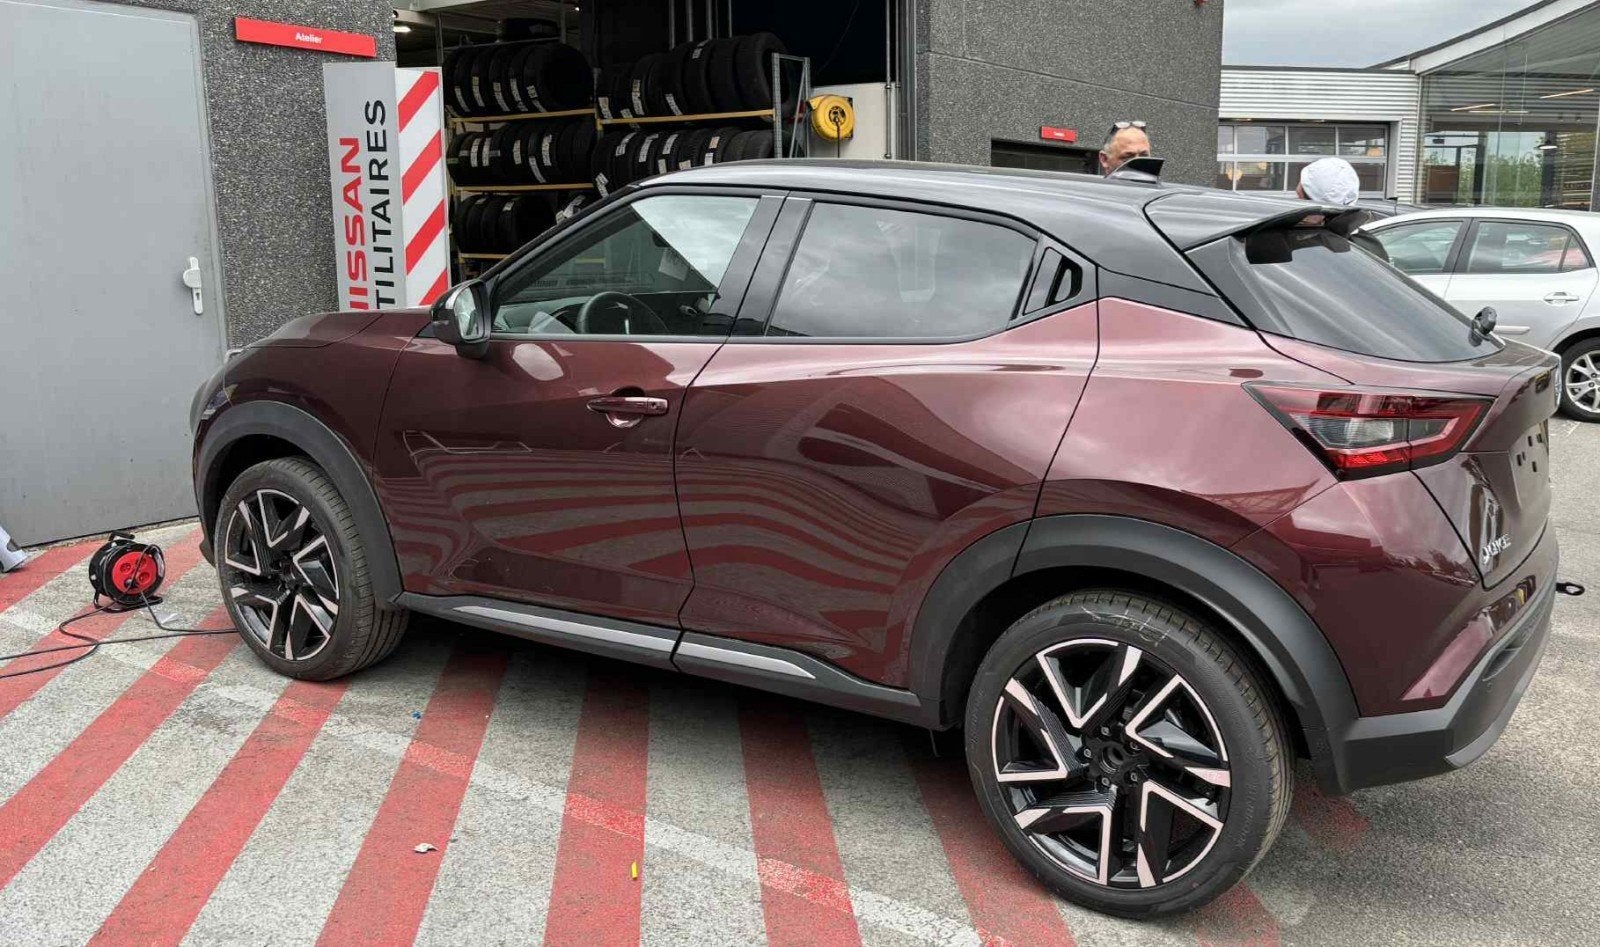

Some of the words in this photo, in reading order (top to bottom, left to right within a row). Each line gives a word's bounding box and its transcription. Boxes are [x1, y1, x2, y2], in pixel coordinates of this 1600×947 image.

[295, 32, 323, 44] Atelier
[340, 137, 369, 310] ISSAN
[365, 100, 396, 309] TILITAIRES
[1481, 533, 1512, 564] JUKE
